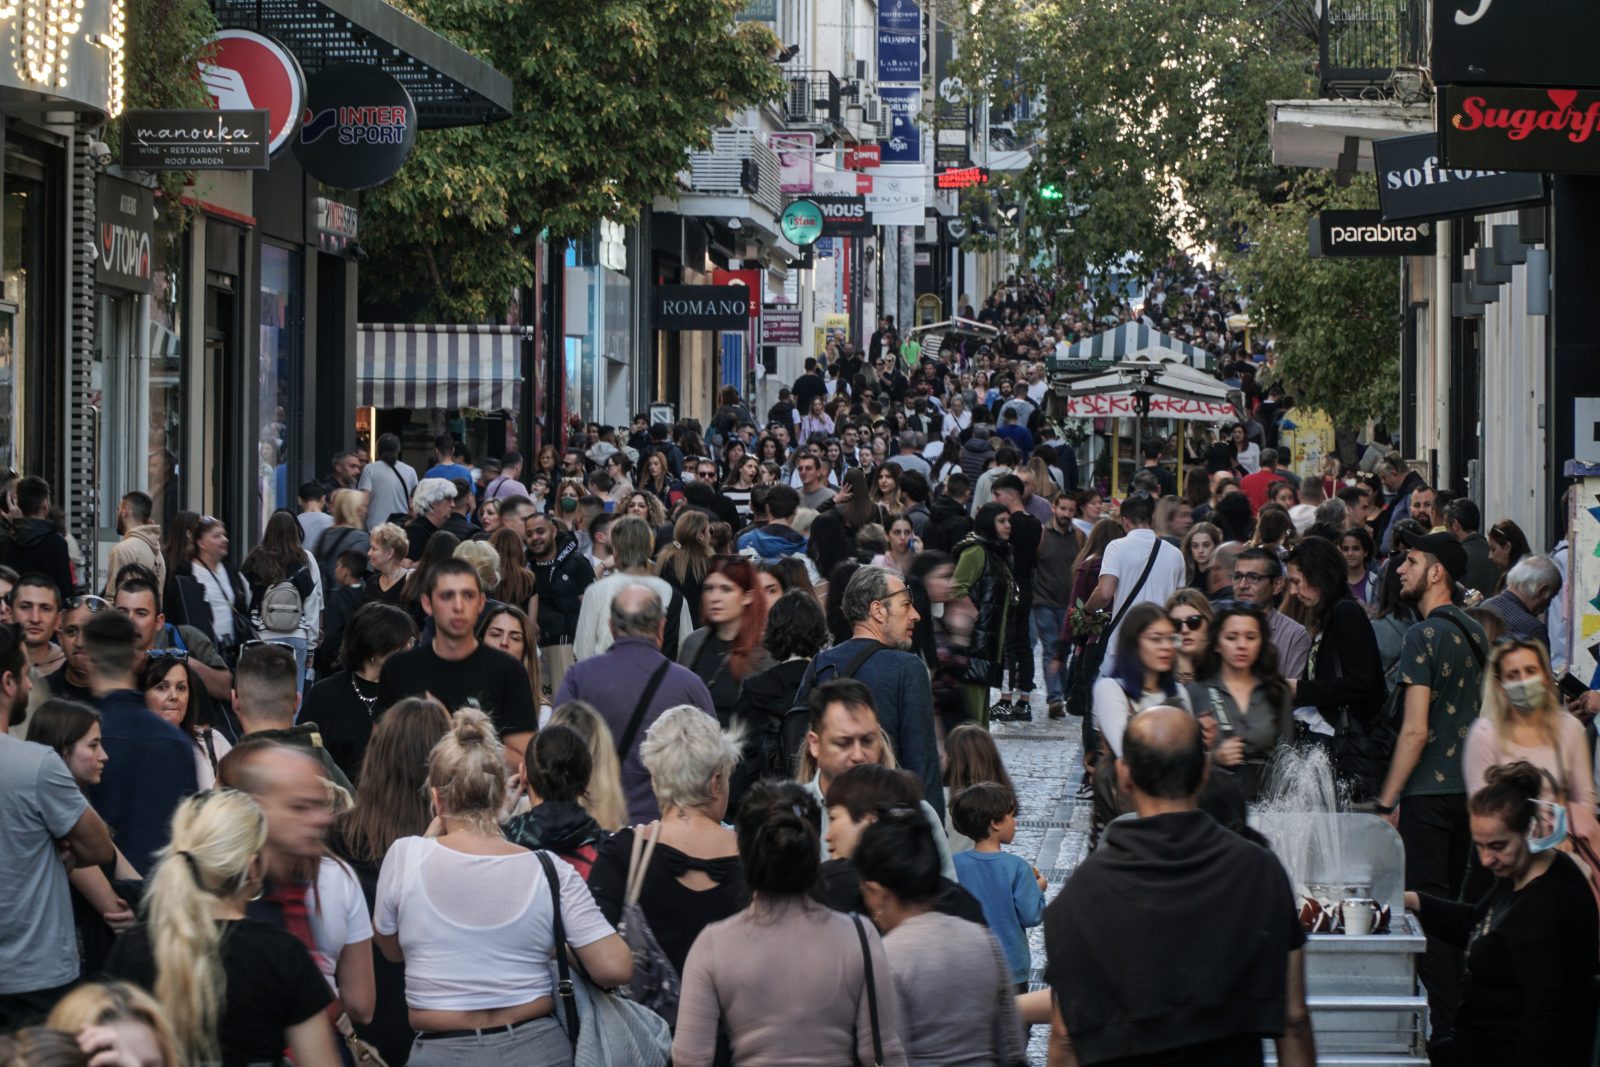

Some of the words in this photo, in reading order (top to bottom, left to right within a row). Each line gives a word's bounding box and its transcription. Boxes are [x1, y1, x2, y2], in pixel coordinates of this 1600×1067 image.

[340, 106, 406, 126] INTER
[137, 115, 252, 141] manouka
[339, 125, 406, 144] SPORT
[821, 203, 864, 217] MOUS
[662, 300, 746, 315] ROMANO
